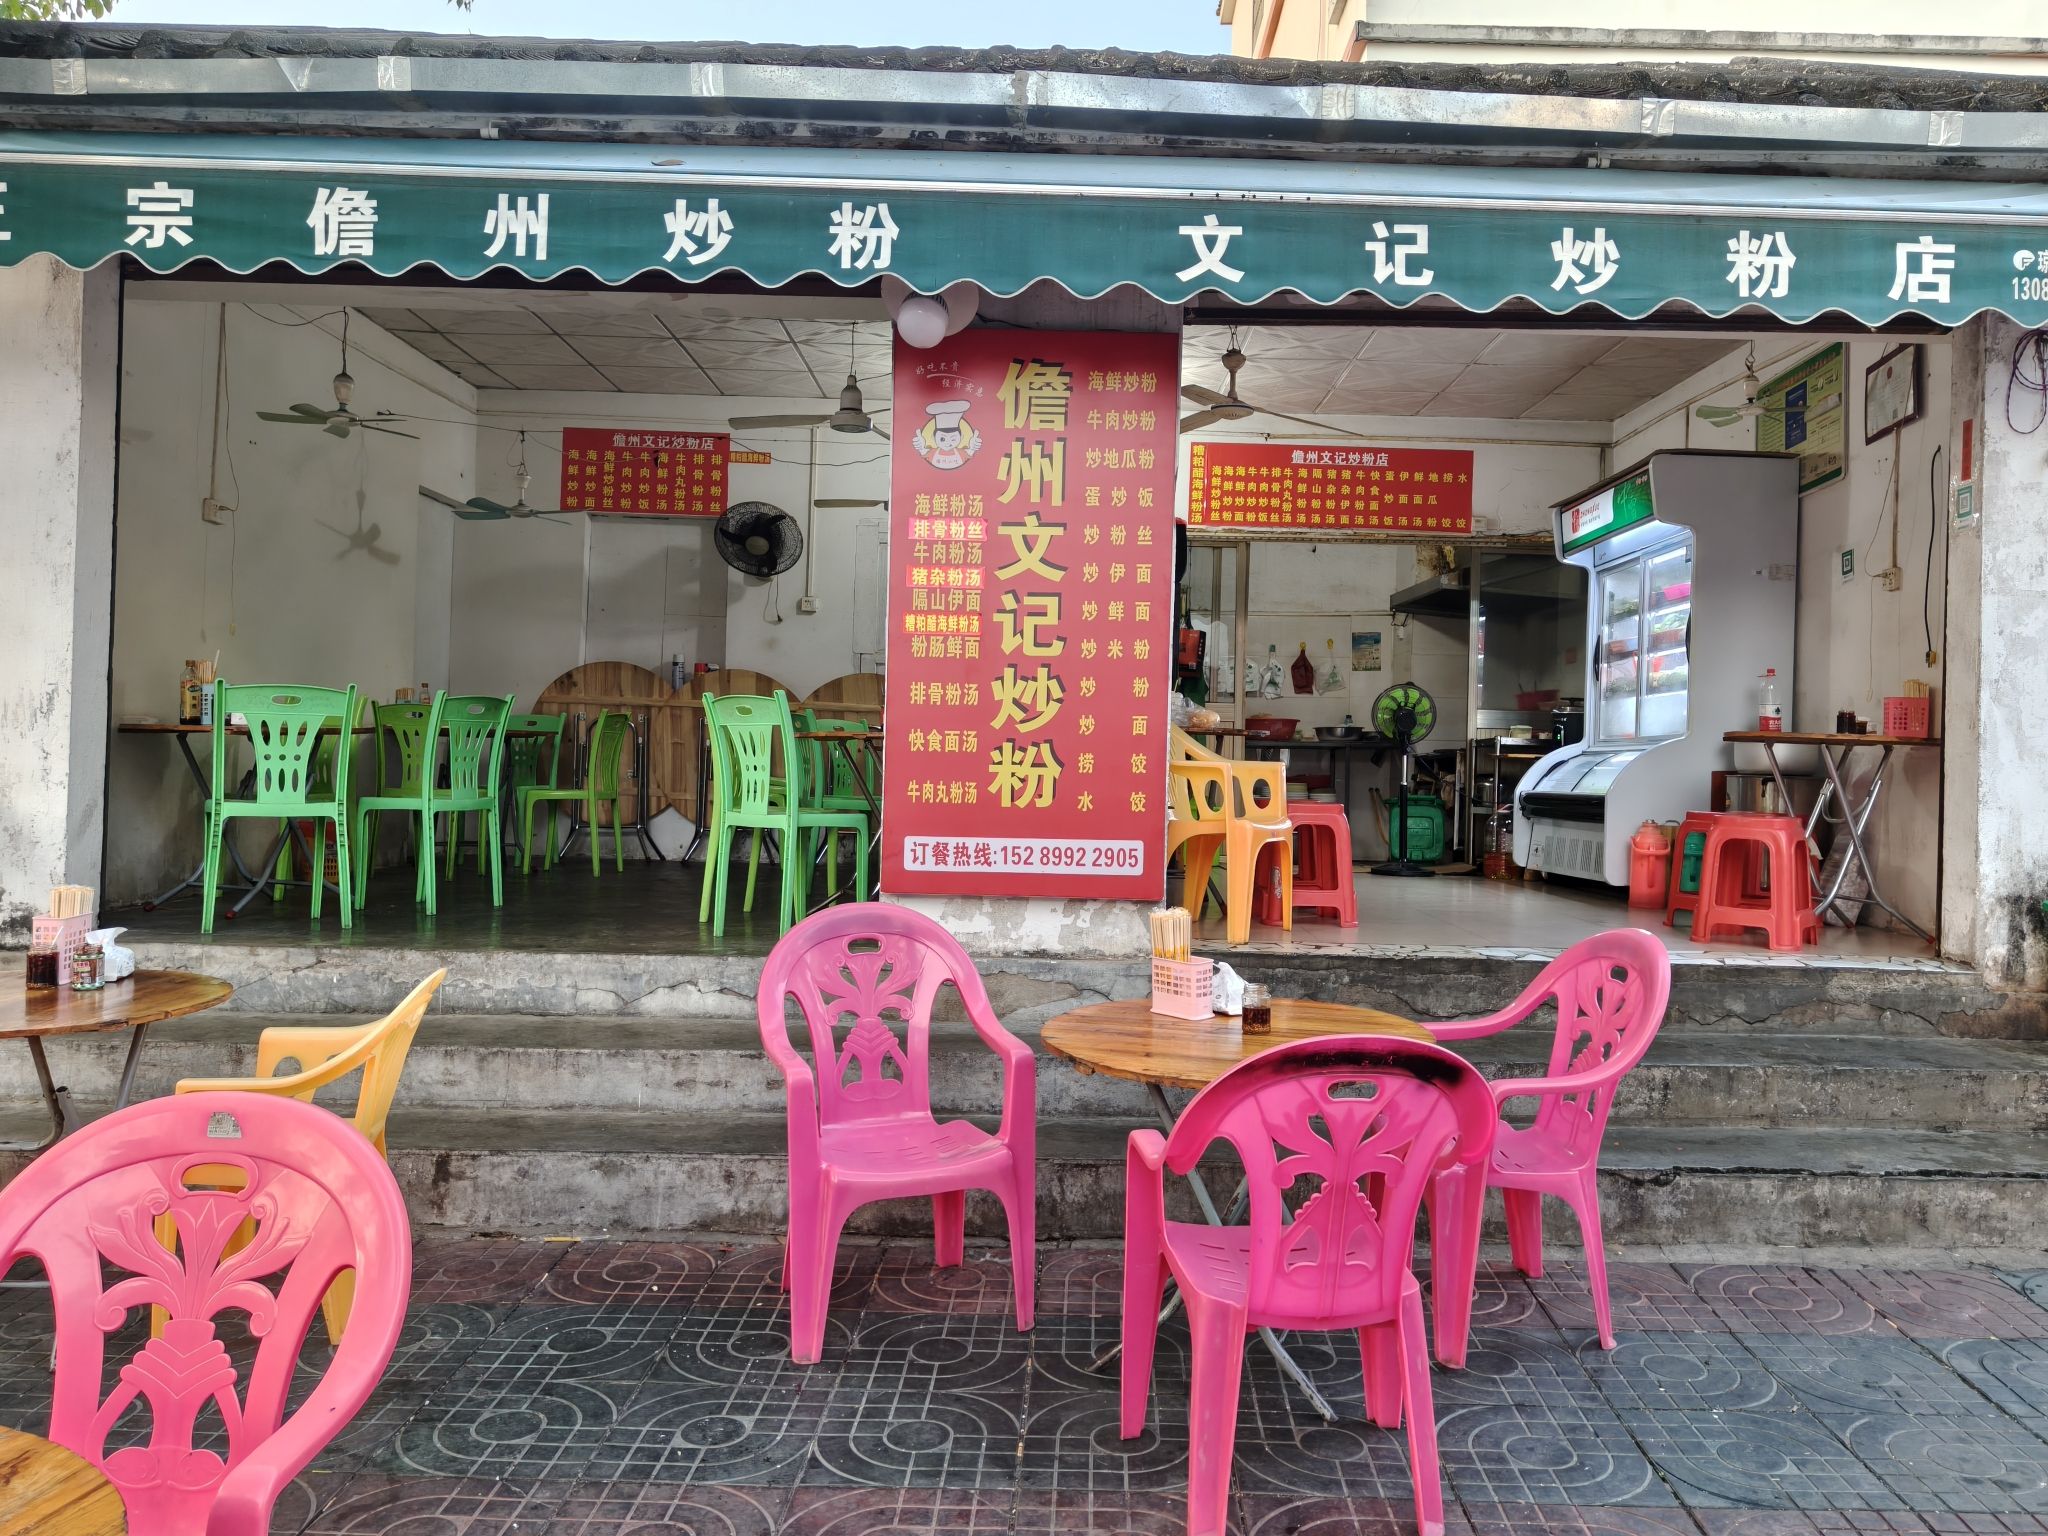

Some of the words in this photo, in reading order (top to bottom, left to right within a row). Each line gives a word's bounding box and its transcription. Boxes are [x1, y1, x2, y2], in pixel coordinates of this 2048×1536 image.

[0, 181, 900, 270] 宗儋州炒粉
[1176, 213, 1956, 304] 文记炒粉店
[1089, 371, 1157, 393] 海鲜炒粉
[1087, 410, 1156, 431] 牛肉炒粉
[612, 433, 714, 449] 儋州文记炒粉店
[1086, 449, 1155, 469] 炒地瓜粉
[1291, 450, 1389, 466] 儋州文记炒粉店
[567, 450, 579, 507] 海鲜炒粉
[585, 451, 597, 508] 海鲜炒面
[602, 450, 615, 508] 海鲜炒粉丝
[620, 451, 632, 509] 牛肉炒粉
[638, 451, 651, 510] 牛肉炒饭
[656, 452, 669, 510] 海鲜粉汤
[674, 453, 686, 511] 牛肉丸粉汤
[692, 453, 704, 512] 排骨粉汤
[710, 454, 722, 512] 排骨粉丝
[1085, 487, 1153, 507] 蛋炒饭
[1211, 465, 1221, 521] 海鲜炒粉丝
[1222, 466, 1234, 521] 海鲜炒粉
[1234, 466, 1246, 521] 海鲜炒面
[1246, 467, 1257, 522] 牛肉炒粉
[1258, 467, 1269, 522] 牛肉炒饭
[1270, 467, 1281, 522] 排骨粉丝
[1282, 468, 1293, 523] 牛肉丸粉汤
[1297, 468, 1308, 523] 海鲜粉汤
[1311, 469, 1322, 524] 隔山粉汤
[1326, 469, 1337, 525] 猪杂粉汤
[1340, 469, 1351, 525] 猪杂伊面
[1354, 470, 1365, 525] 牛肉粉汤
[1369, 470, 1380, 525] 快食面汤
[914, 494, 984, 517] 海鲜粉汤
[914, 521, 983, 539] 排骨粉丝
[1084, 525, 1152, 545] 炒粉丝
[913, 543, 982, 565] 牛肉粉汤
[1083, 563, 1152, 584] 炒伊面
[912, 567, 981, 586] 猪杂粉汤
[988, 358, 1074, 809] 儋州文记炒粉
[912, 589, 981, 612] 隔山伊面
[1082, 601, 1151, 621] 炒鲜面
[911, 635, 980, 659] 粉肠鲜面
[1081, 639, 1150, 660] 炒米粉
[910, 682, 979, 706] 排骨粉汤
[1080, 677, 1149, 697] 炒粉
[909, 729, 978, 752] 快食面汤
[1079, 715, 1148, 735] 炒面
[1078, 753, 1147, 774] 捞饺
[907, 780, 977, 804] 牛肉丸粉汤
[1077, 791, 1146, 812] 水饺
[1039, 845, 1086, 868] 8992
[1092, 846, 1139, 868] 2905
